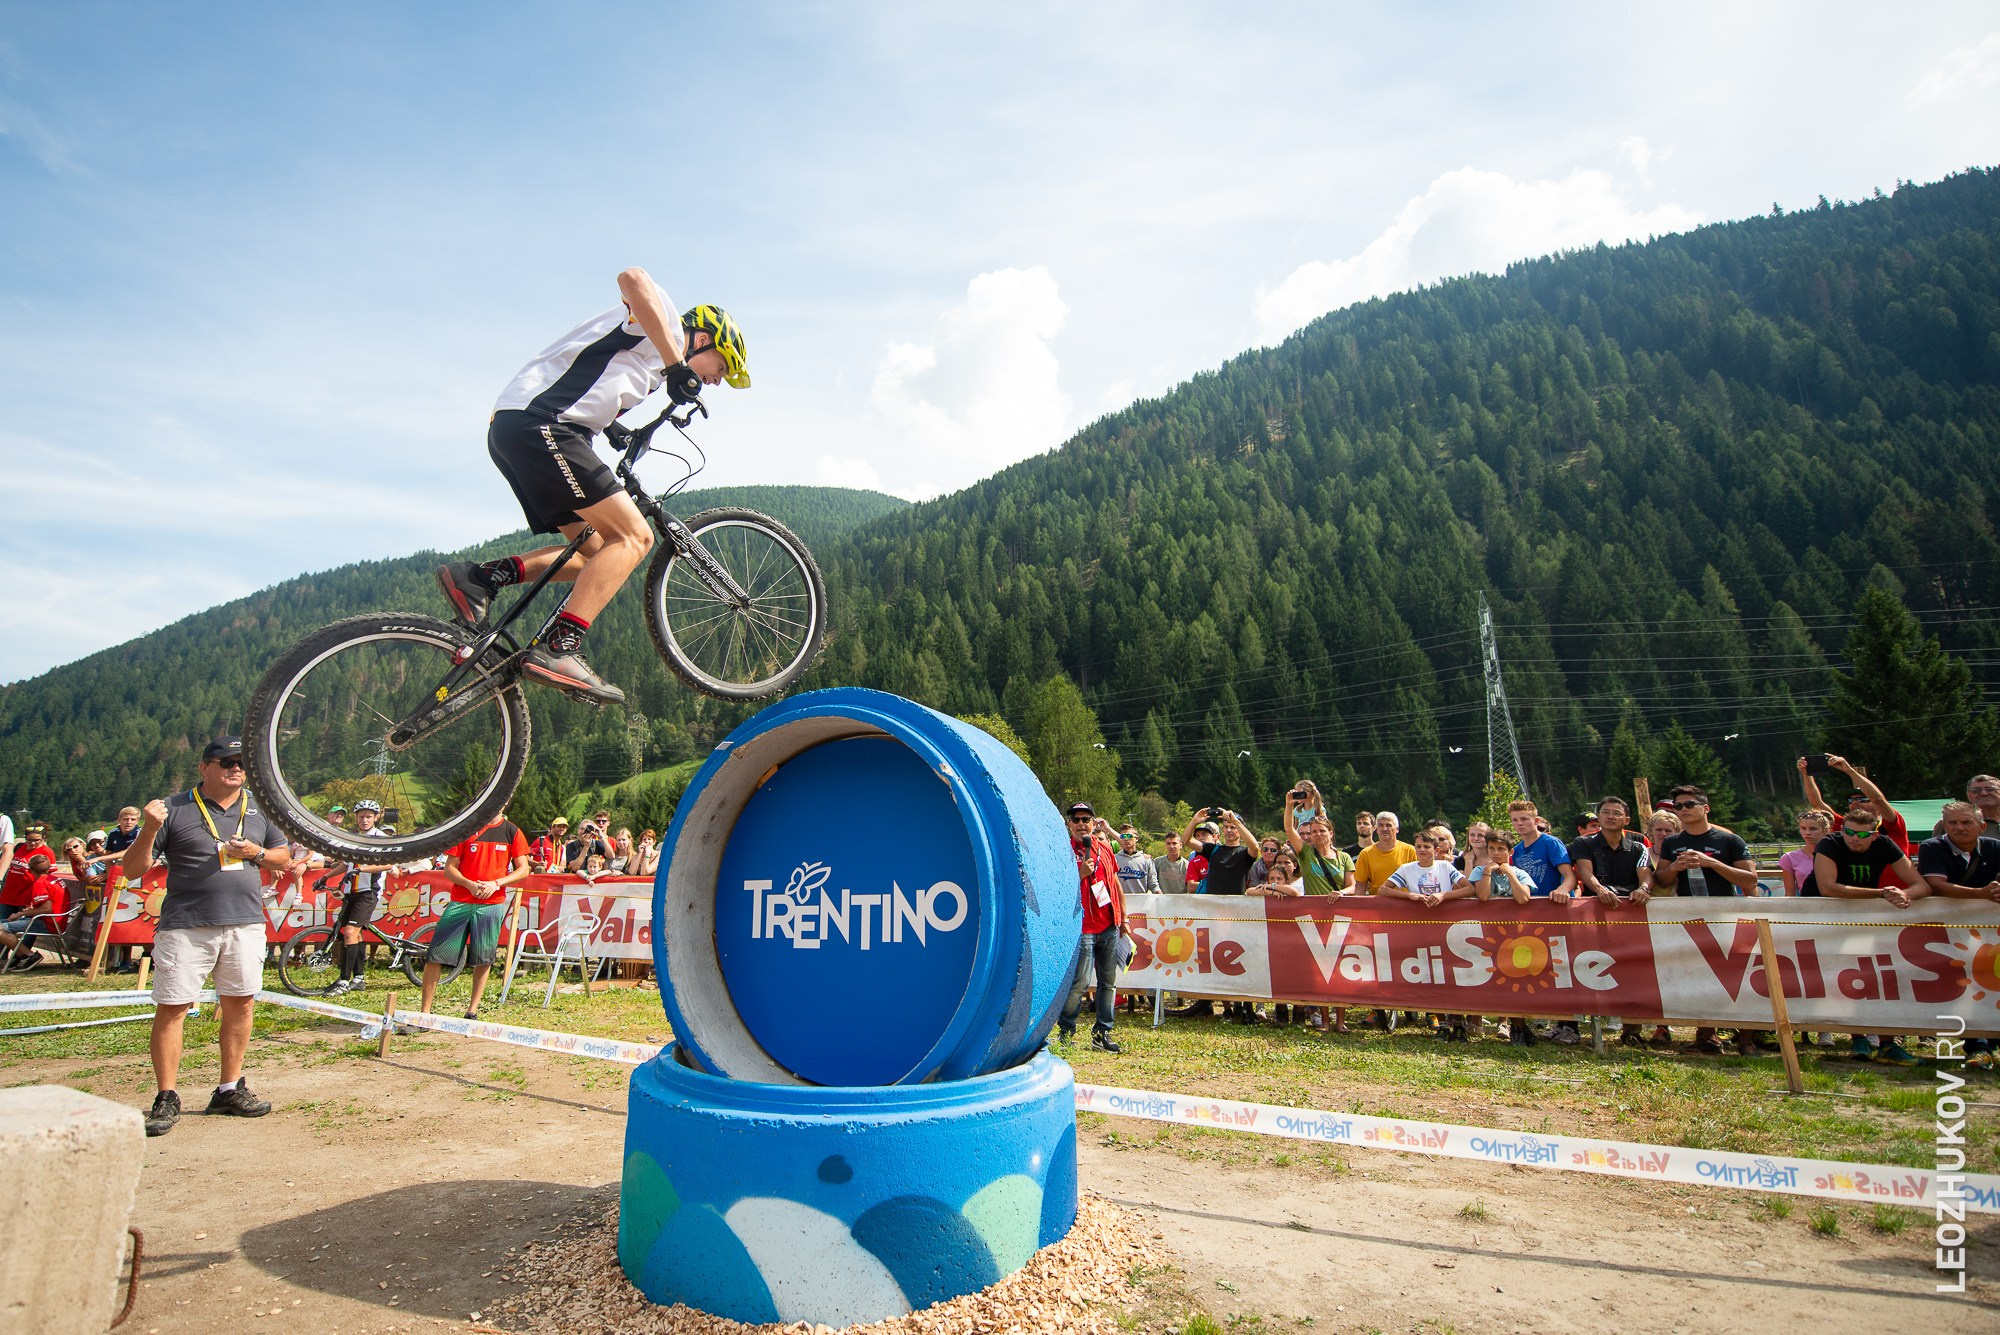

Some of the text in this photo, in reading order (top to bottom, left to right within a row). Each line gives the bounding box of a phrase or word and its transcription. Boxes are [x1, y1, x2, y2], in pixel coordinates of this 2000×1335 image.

[540, 425, 586, 498] TEAM GERMANY
[381, 626, 453, 640] try-all
[577, 896, 636, 946] Val
[743, 879, 968, 950] TRENTINO
[1295, 914, 1392, 984] Val
[1400, 945, 1445, 985] di
[1682, 917, 1826, 1003] Val
[1837, 954, 1901, 1000] di
